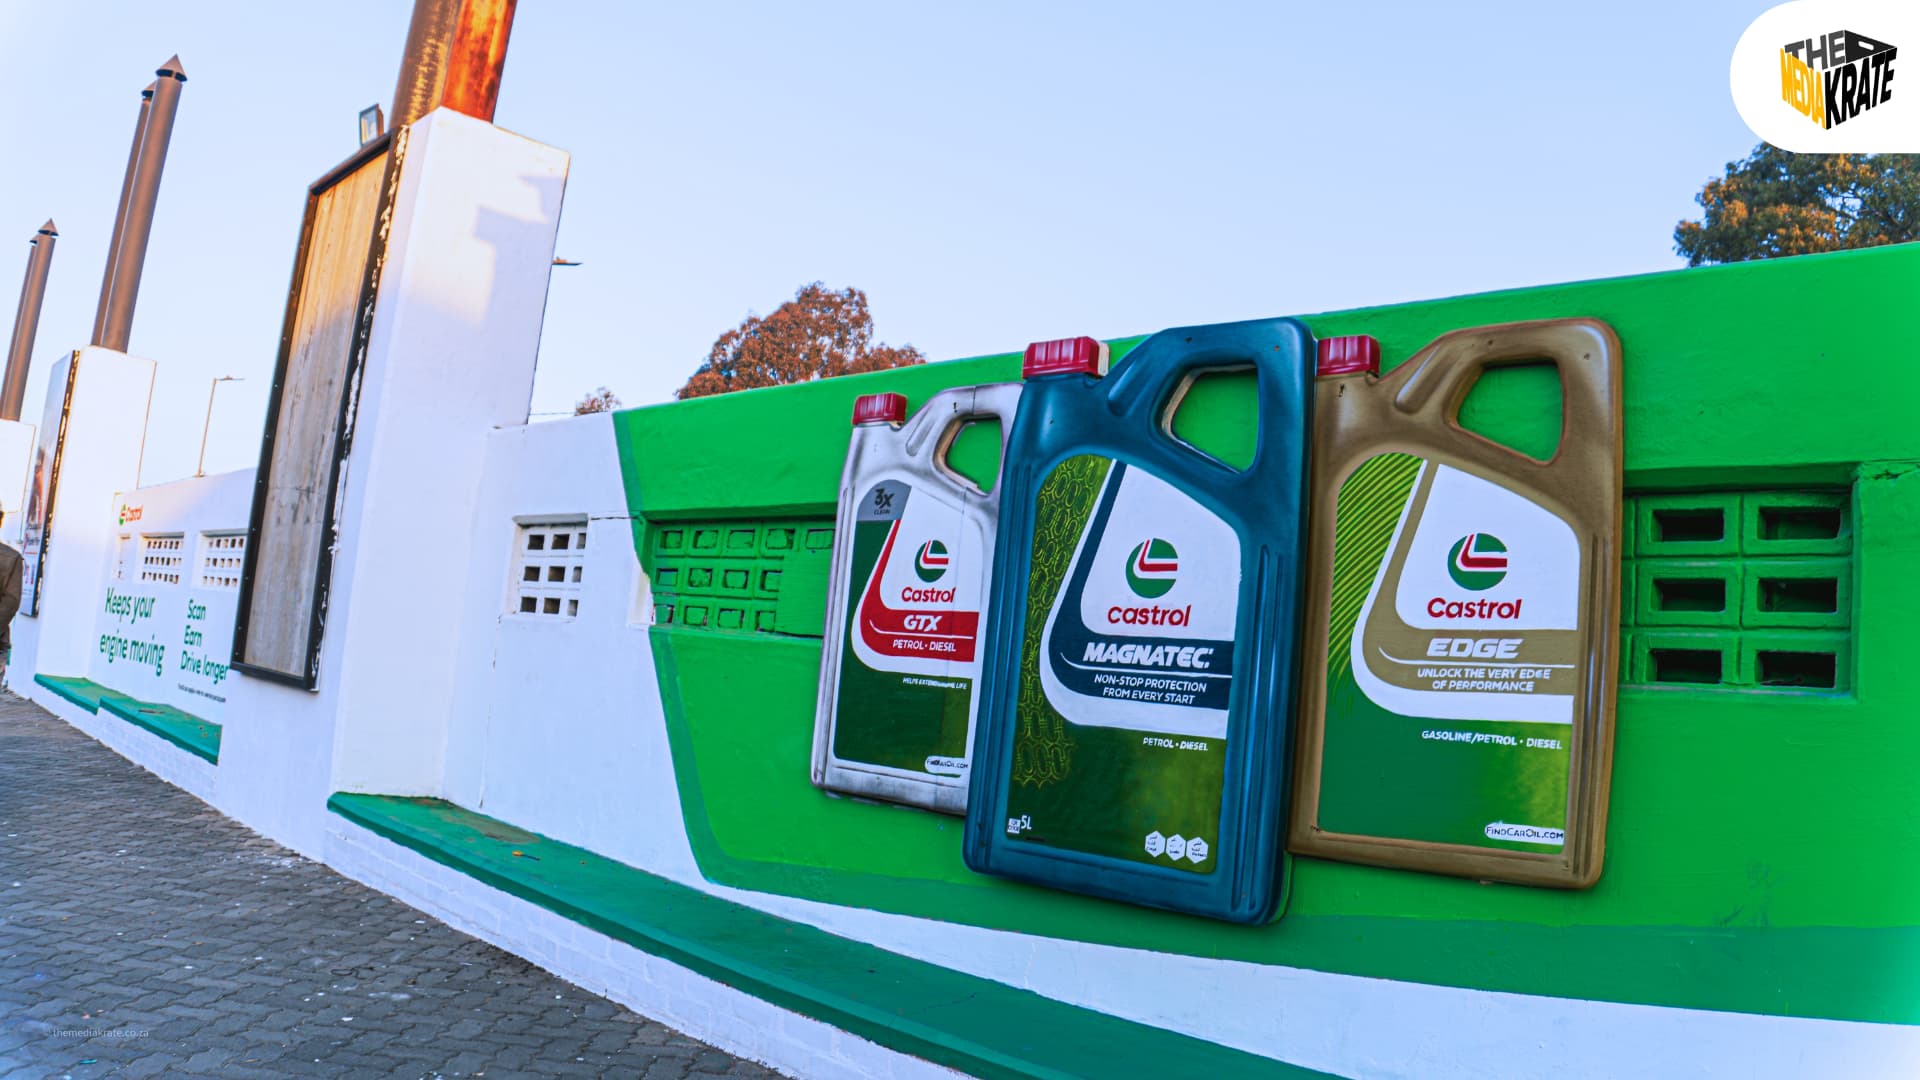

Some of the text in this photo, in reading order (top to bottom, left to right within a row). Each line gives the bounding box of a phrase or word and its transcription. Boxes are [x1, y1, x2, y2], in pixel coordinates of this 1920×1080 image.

[901, 586, 957, 603] Castrol
[105, 587, 156, 625] Keeps your
[187, 598, 206, 620] Scan
[1427, 597, 1523, 620] Castrol
[903, 614, 943, 632] GTX
[184, 624, 202, 647] Earn
[99, 628, 165, 677] engine moving
[892, 639, 957, 652] PETROL DIESEL
[1426, 637, 1524, 659] EDGE
[180, 650, 229, 685] Drive longer
[1417, 668, 1552, 680] UNLOCK THE VERY EDGE
[1094, 674, 1207, 693] NON-STOP PROTECTION
[1432, 680, 1535, 692] OF PERFORMANCE
[1103, 687, 1196, 705] FROM EVERY START
[1143, 737, 1209, 752] PETROL DIESEL
[1421, 730, 1563, 750] GASOLINE/PETROL DIESEL
[1020, 814, 1032, 831] 5L
